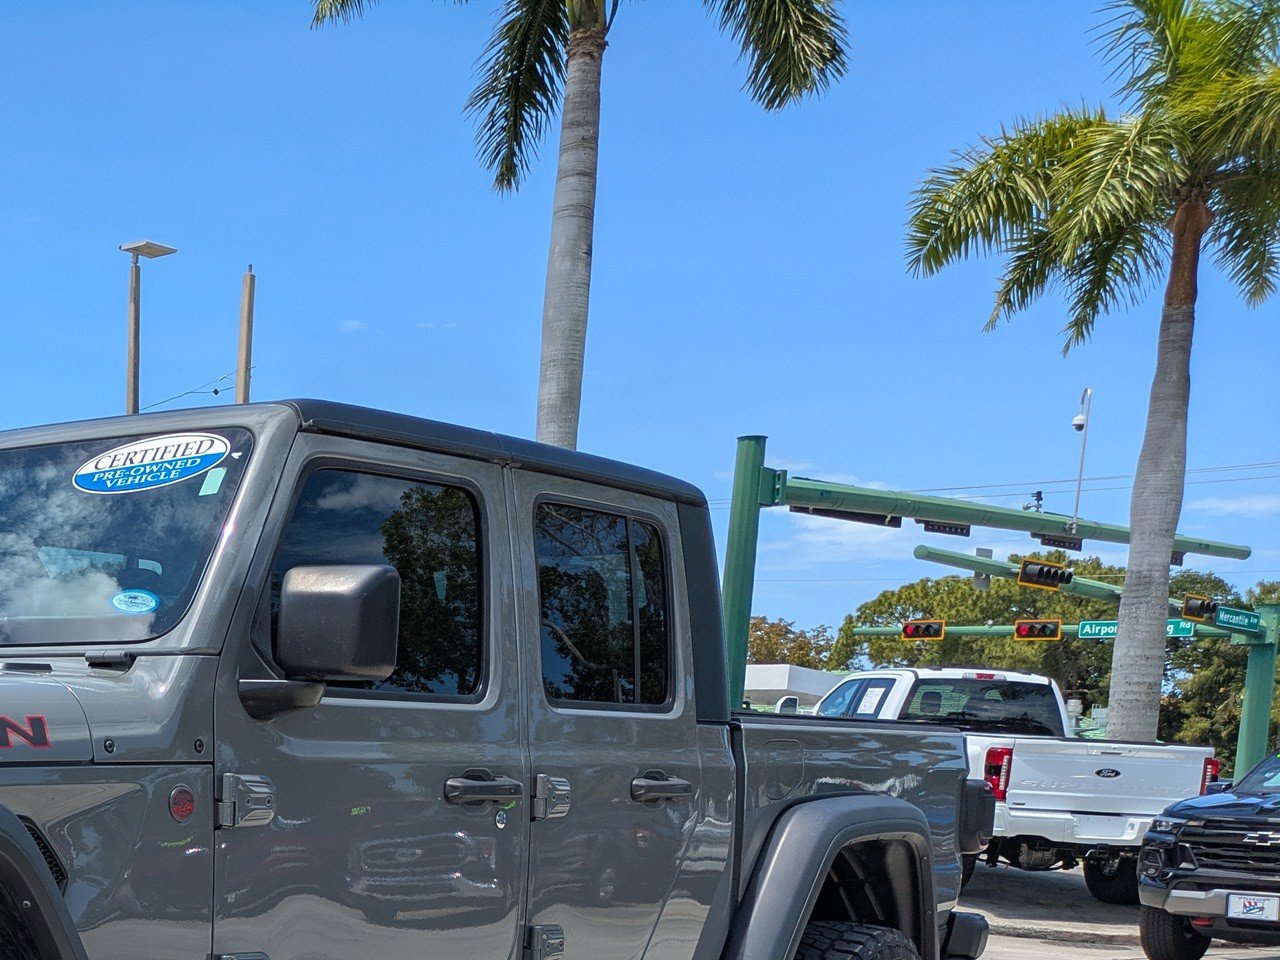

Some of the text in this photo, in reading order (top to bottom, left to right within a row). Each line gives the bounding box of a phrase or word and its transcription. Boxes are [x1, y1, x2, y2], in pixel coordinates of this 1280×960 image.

[94, 439, 215, 471] CERTIFIED
[93, 458, 202, 482] PRE-OWNED
[105, 469, 182, 488] VEHICLE
[1179, 621, 1191, 630] Rd
[1219, 611, 1258, 626] Mercantile Ave
